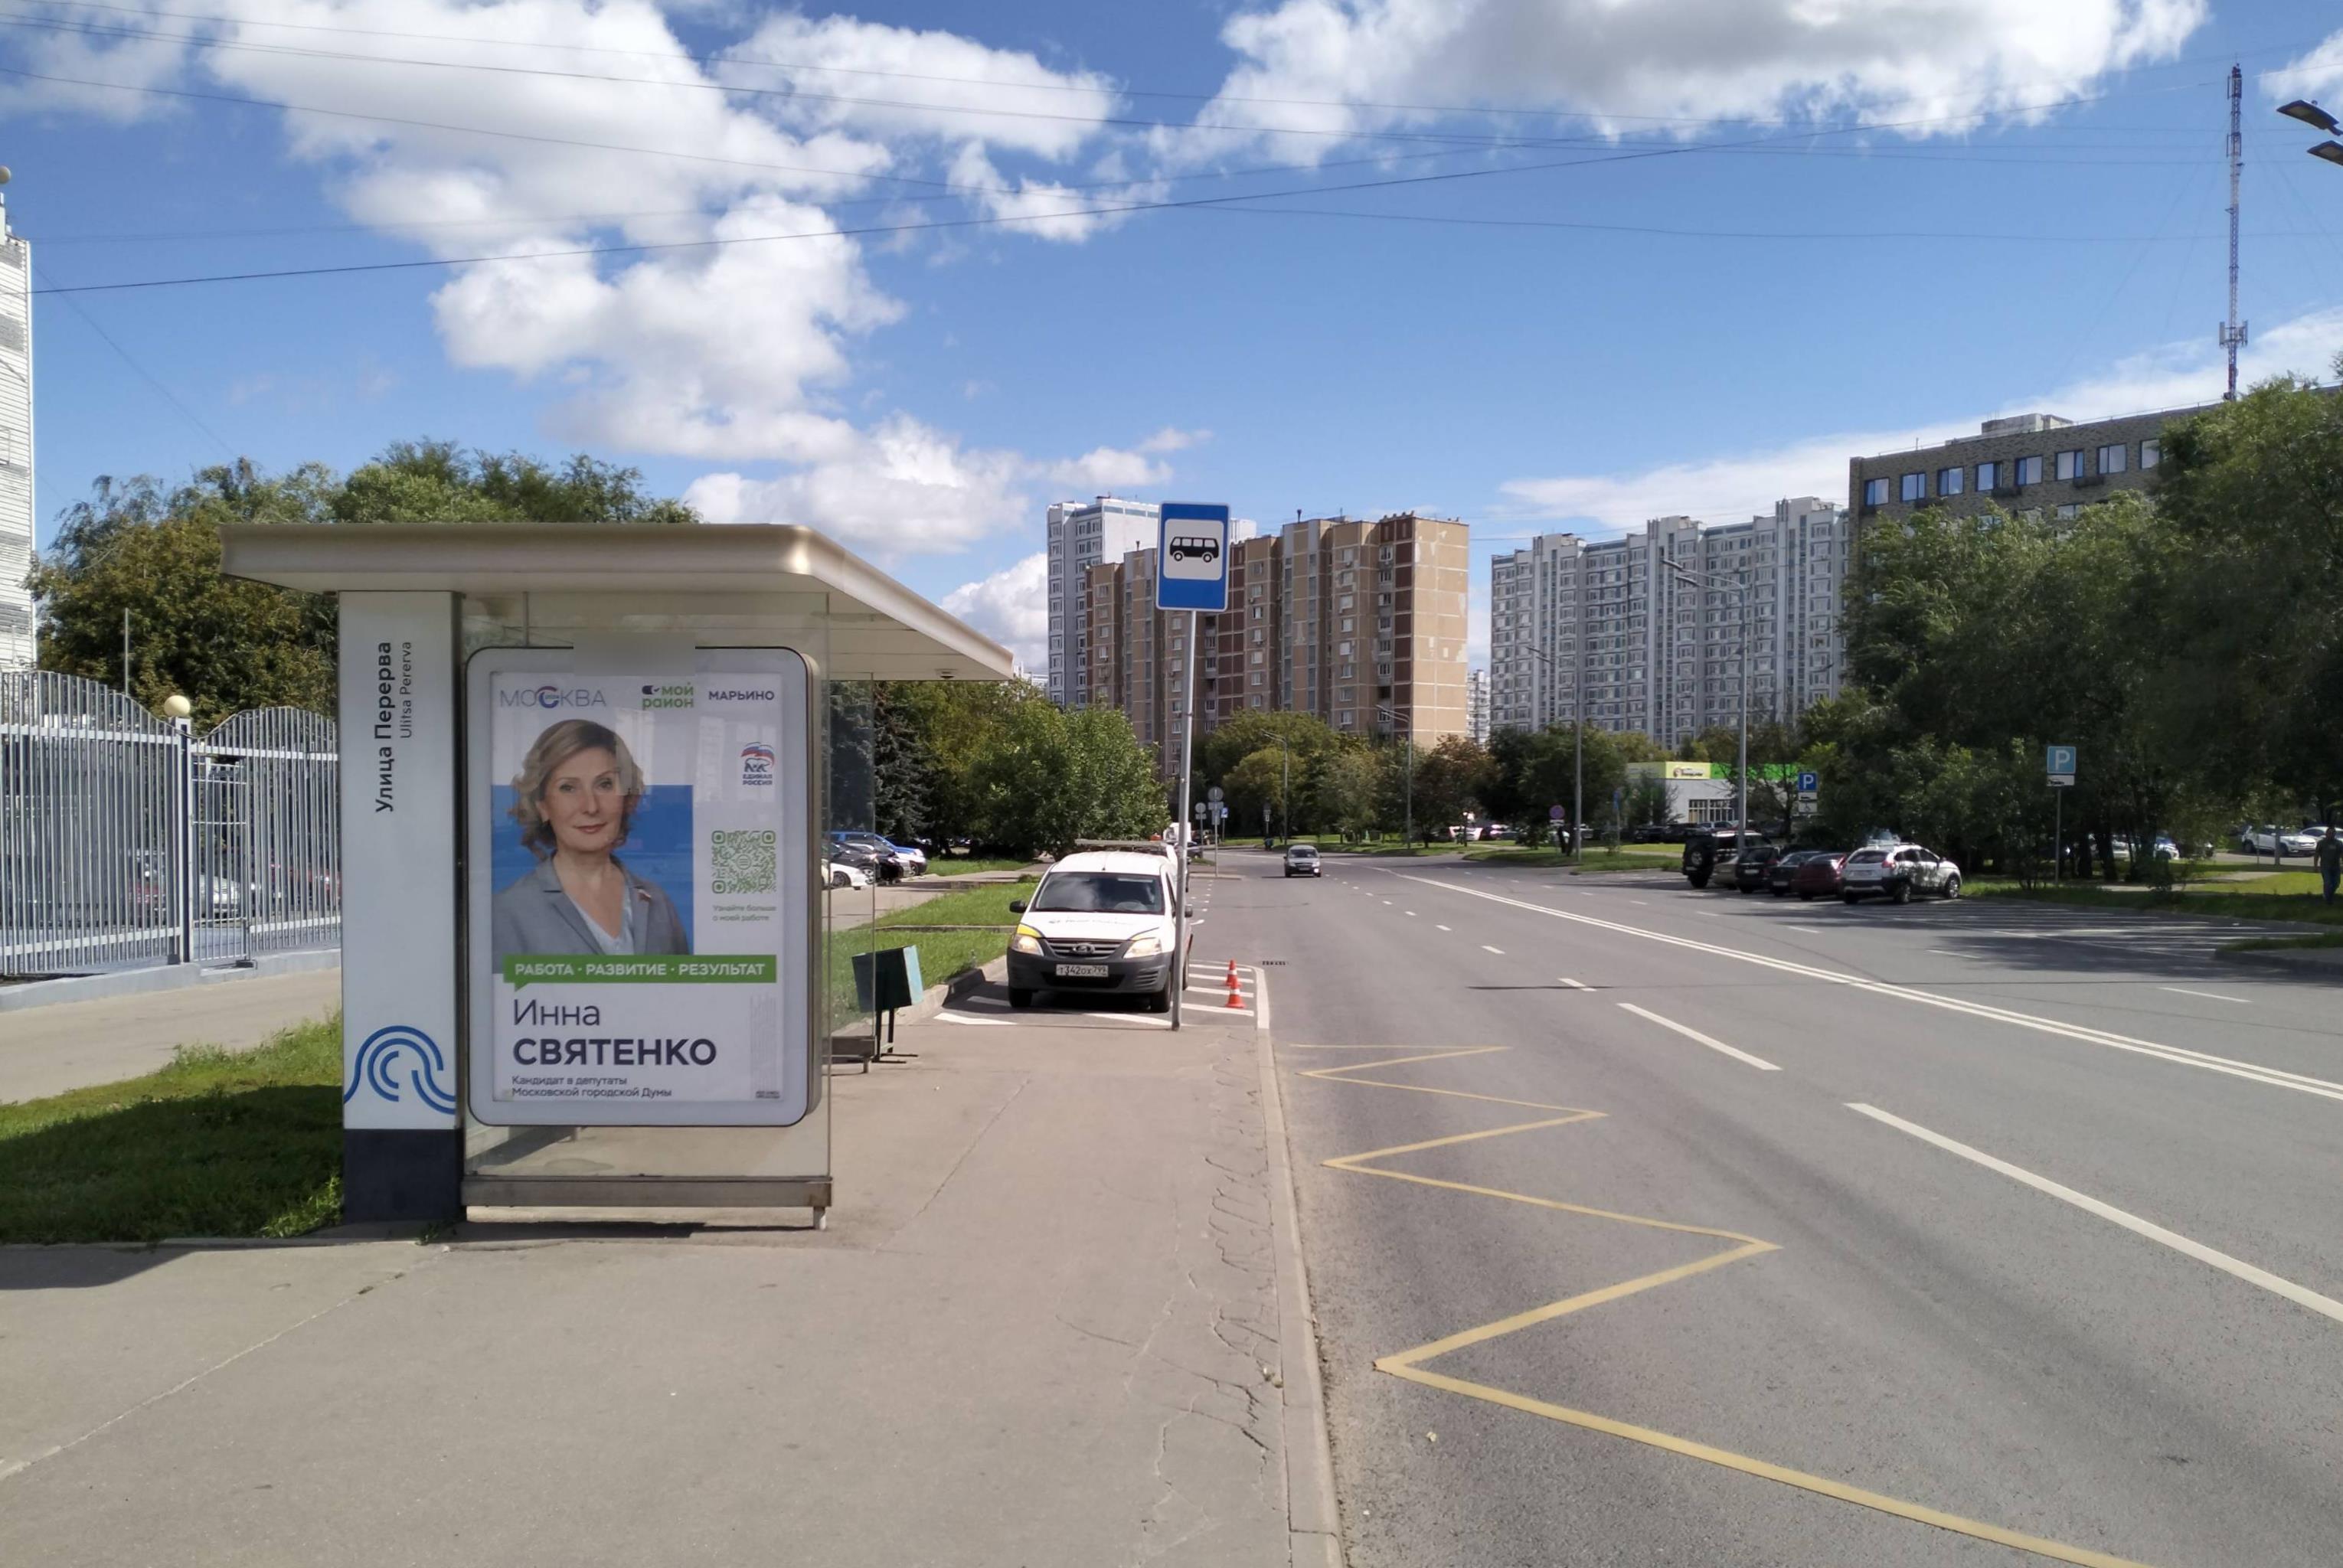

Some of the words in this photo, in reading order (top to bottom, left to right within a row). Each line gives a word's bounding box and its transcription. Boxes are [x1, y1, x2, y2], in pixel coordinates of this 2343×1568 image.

[399, 642, 412, 695] Pererva
[374, 642, 395, 740] Перерва
[500, 686, 607, 708] МОСКВА
[708, 691, 775, 701] МАРЬИНО
[400, 700, 412, 739] Ulitsa
[374, 746, 395, 813] Улица
[515, 964, 574, 976] РАБОТА
[586, 964, 667, 976] РАЗВИТИЕ
[678, 963, 765, 975] РЕЗУЛЬТАТ
[514, 998, 600, 1026] Инна
[513, 1038, 717, 1066] СВЯТЕНКО
[512, 1076, 564, 1086] Кандидат
[575, 1077, 627, 1087] депутаты
[512, 1087, 580, 1097] Московской
[582, 1088, 639, 1098] городской
[642, 1088, 672, 1099] Думы
